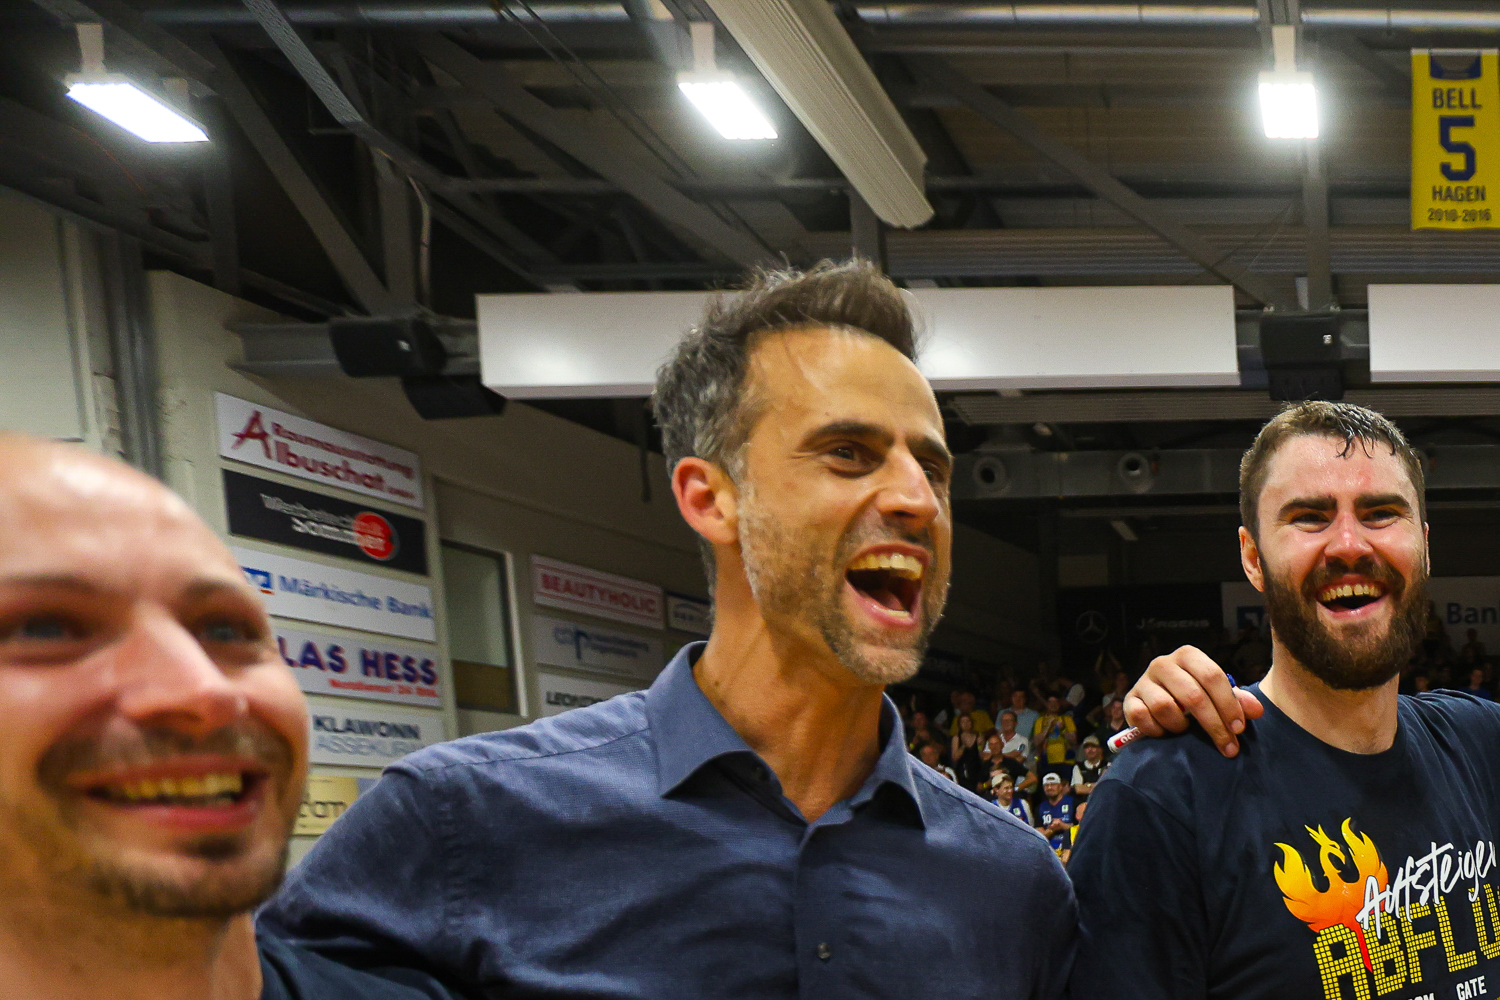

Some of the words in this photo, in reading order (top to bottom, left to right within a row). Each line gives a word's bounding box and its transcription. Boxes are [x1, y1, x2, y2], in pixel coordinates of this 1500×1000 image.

[1432, 87, 1483, 109] BELL
[1439, 115, 1477, 181] 5
[1431, 185, 1487, 202] HAGEN
[279, 574, 383, 611] Märkische
[386, 595, 434, 619] Bank
[360, 648, 440, 687] HESS
[312, 714, 421, 740] KLAWONN
